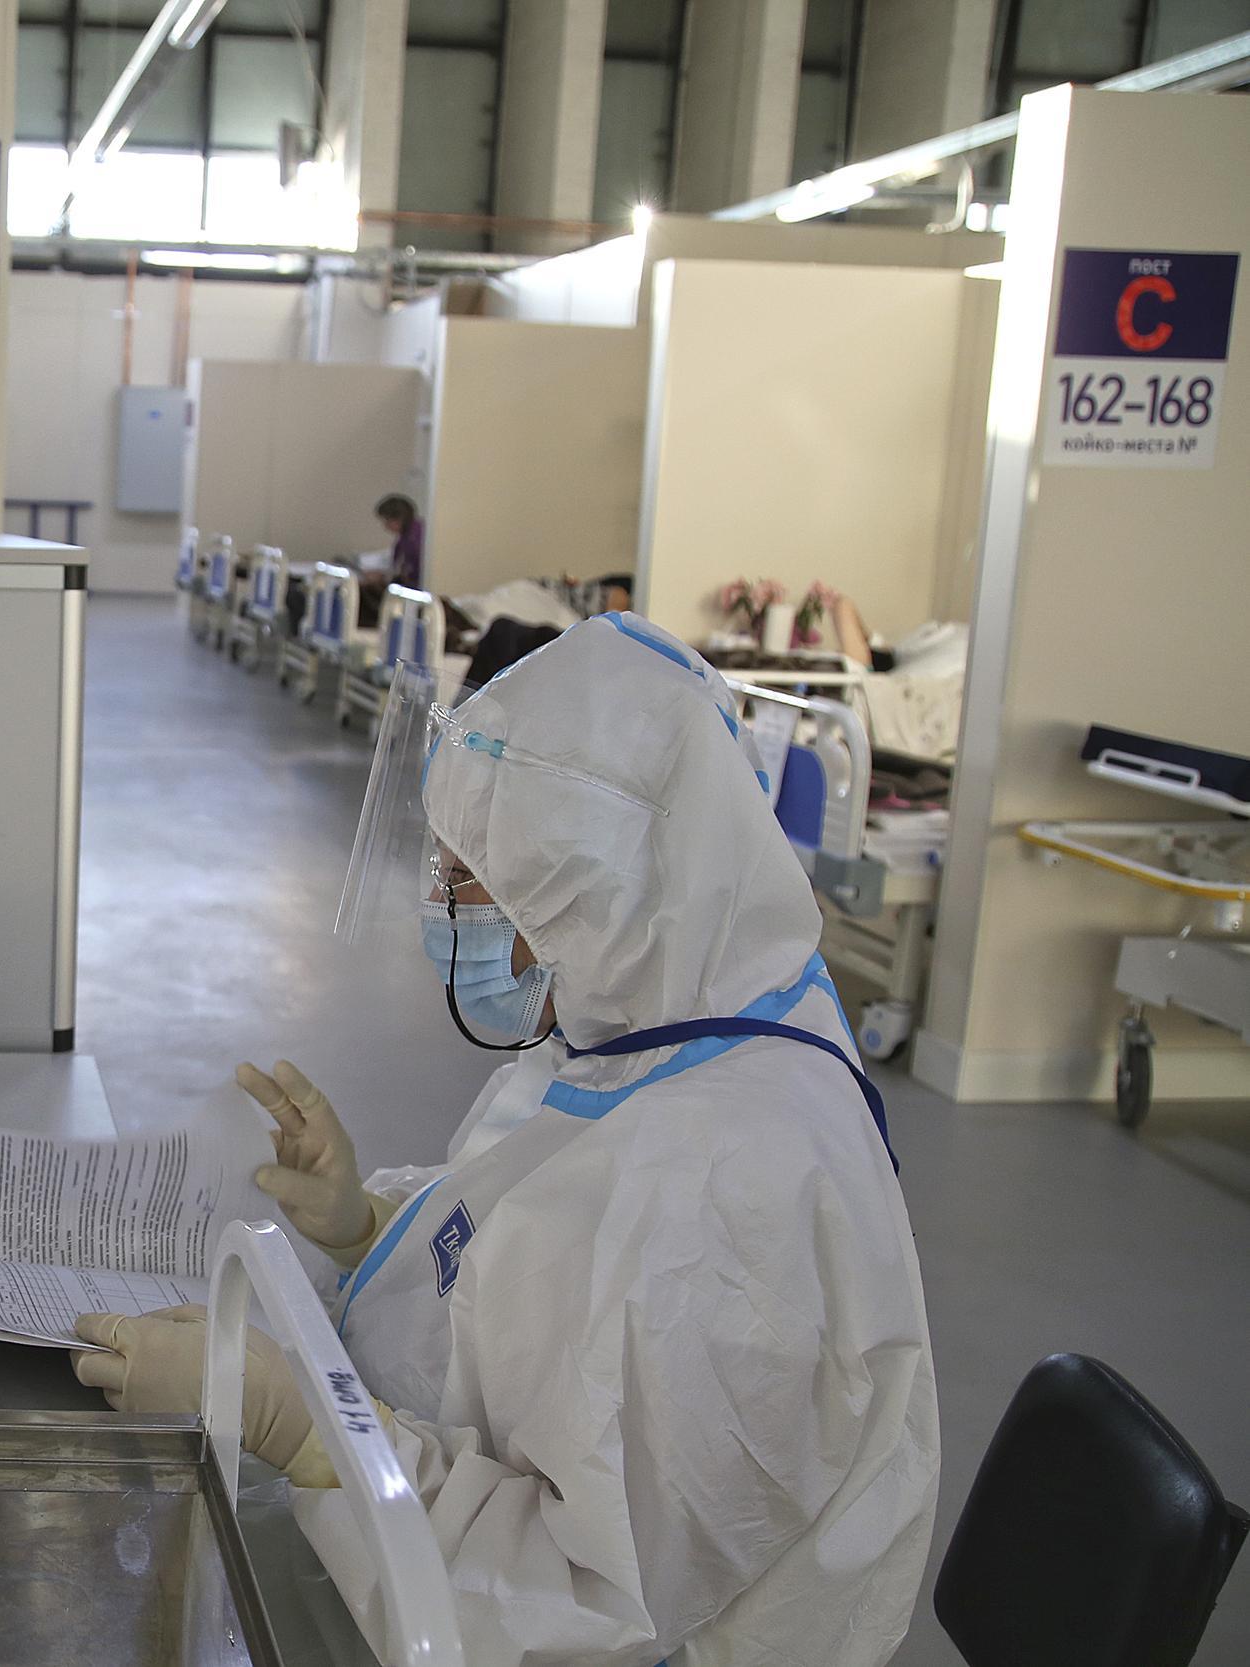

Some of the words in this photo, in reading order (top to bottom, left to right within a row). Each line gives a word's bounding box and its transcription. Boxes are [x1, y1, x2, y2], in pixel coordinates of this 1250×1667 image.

[1128, 259, 1172, 275] пост
[1059, 373, 1214, 427] 162-168
[1063, 433, 1175, 455] койко-места
